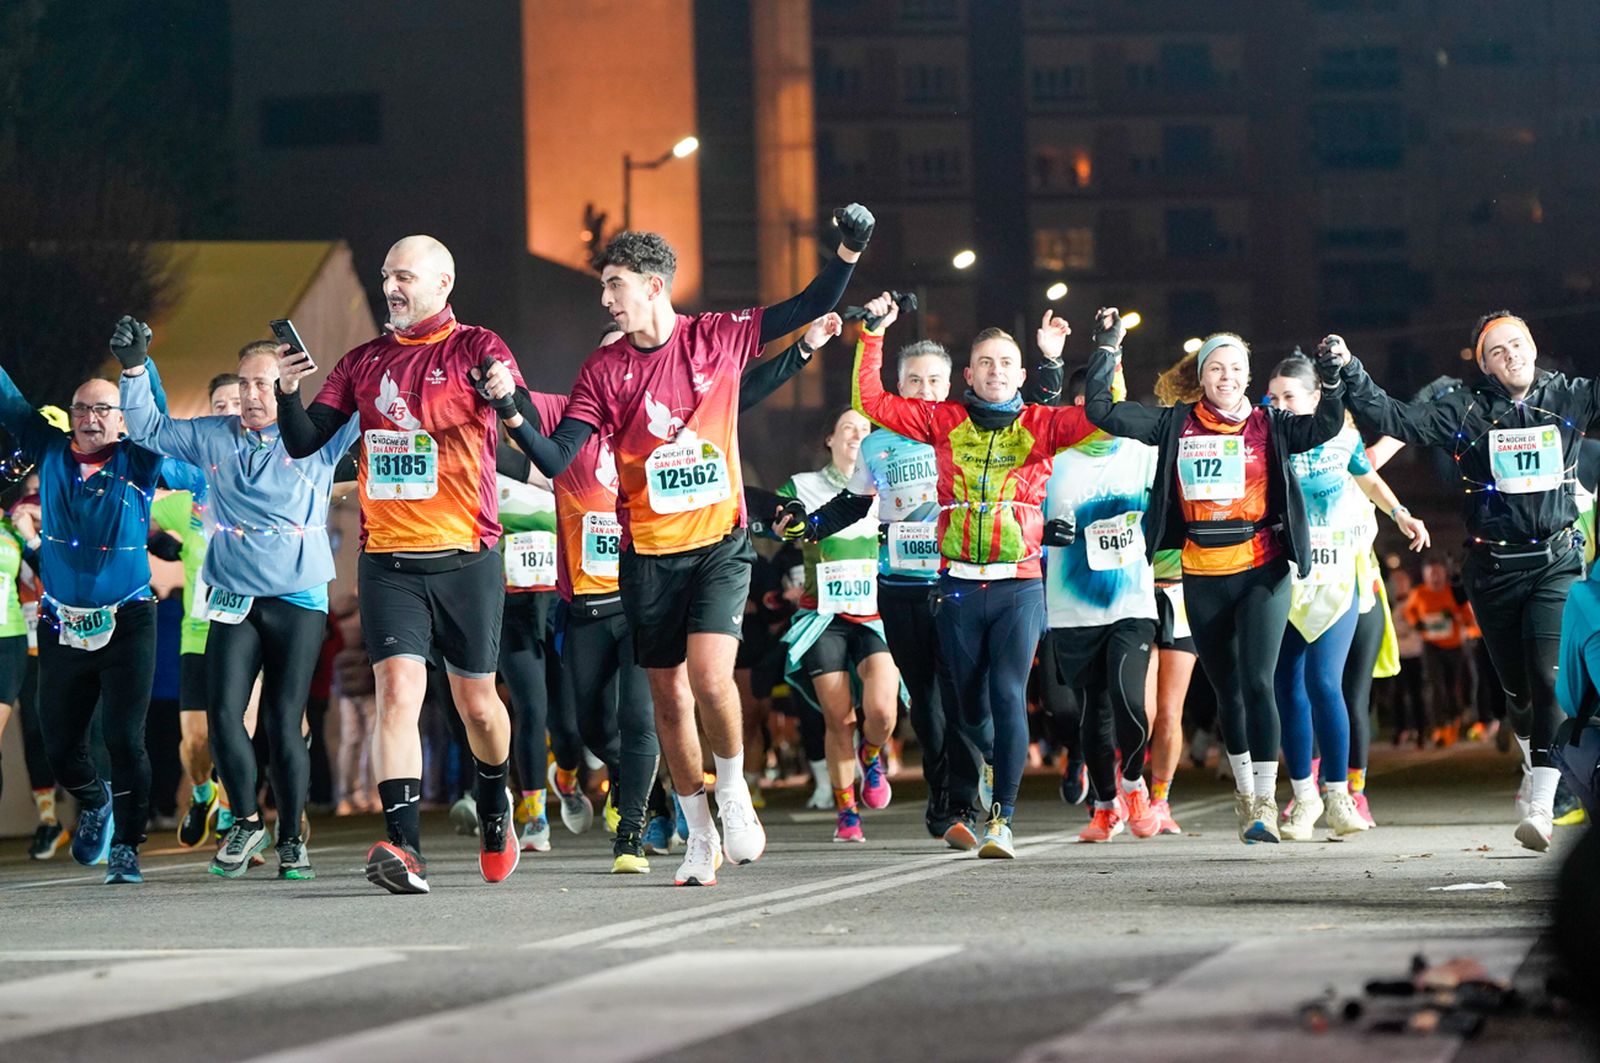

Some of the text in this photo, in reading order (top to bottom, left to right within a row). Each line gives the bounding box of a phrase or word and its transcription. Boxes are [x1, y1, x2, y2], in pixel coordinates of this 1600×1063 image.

[387, 402, 406, 421] 43
[377, 437, 398, 446] NOCHE
[1506, 436, 1527, 444] NOCHE
[662, 451, 685, 459] NOCHE
[1514, 450, 1540, 471] 171
[375, 454, 427, 476] 13185
[654, 461, 670, 469] SAN
[1193, 458, 1222, 478] 172
[656, 462, 719, 490] 12562
[1099, 528, 1134, 550] 6462
[902, 540, 939, 555] 10850
[520, 551, 554, 567] 1874
[826, 580, 870, 596] 12090
